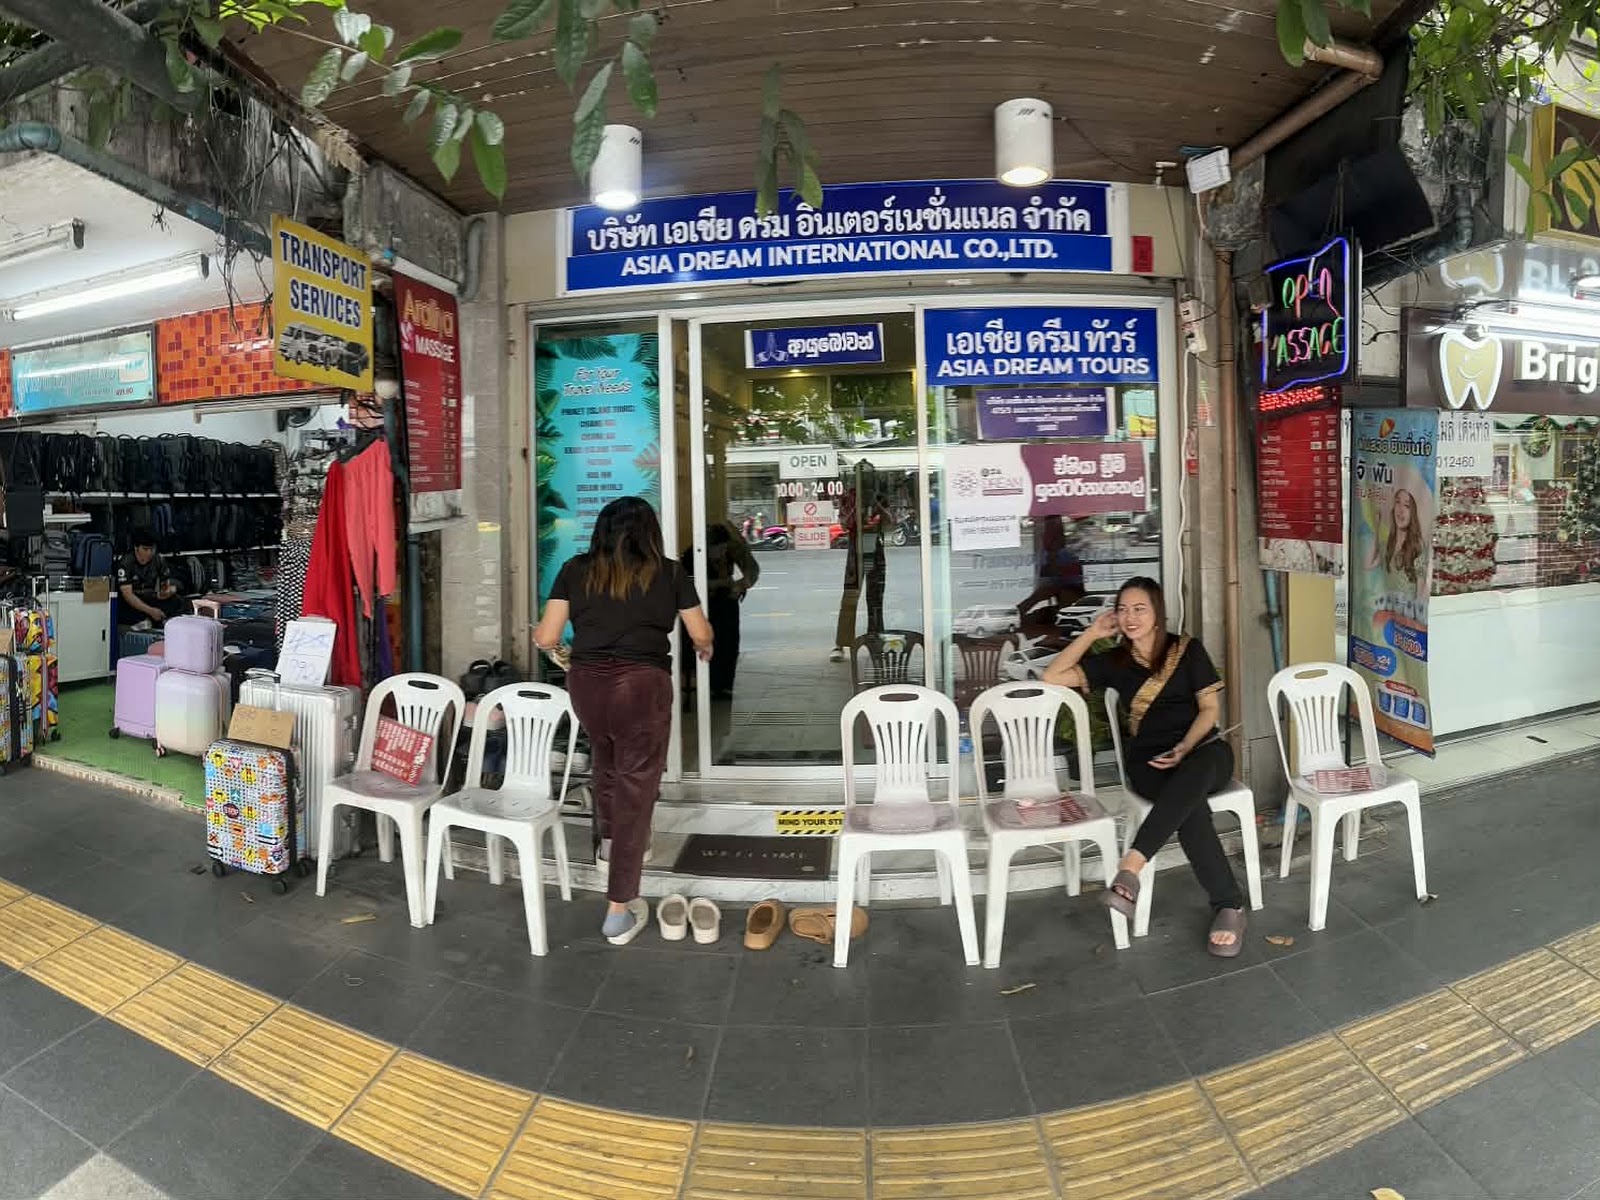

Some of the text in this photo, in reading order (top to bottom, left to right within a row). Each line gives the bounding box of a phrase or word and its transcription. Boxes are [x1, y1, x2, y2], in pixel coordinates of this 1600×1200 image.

[587, 187, 1092, 251] บริษัท เอเชีย ดรม อินเตอร์เนชั่นแนล จำกัด
[280, 231, 367, 290] TRANSPORT
[620, 257, 674, 277] ASIA
[678, 248, 762, 272] DREAM
[768, 238, 959, 266] INTERNATIONAL
[290, 279, 361, 328] SERVICES
[946, 317, 1138, 355] เอเชีย ดรีม ทัวร์
[937, 357, 1149, 377] ASIA DREAM TOURS
[790, 455, 827, 467] OPEN
[799, 533, 826, 541] SLIDE
[778, 818, 800, 826] MIND
